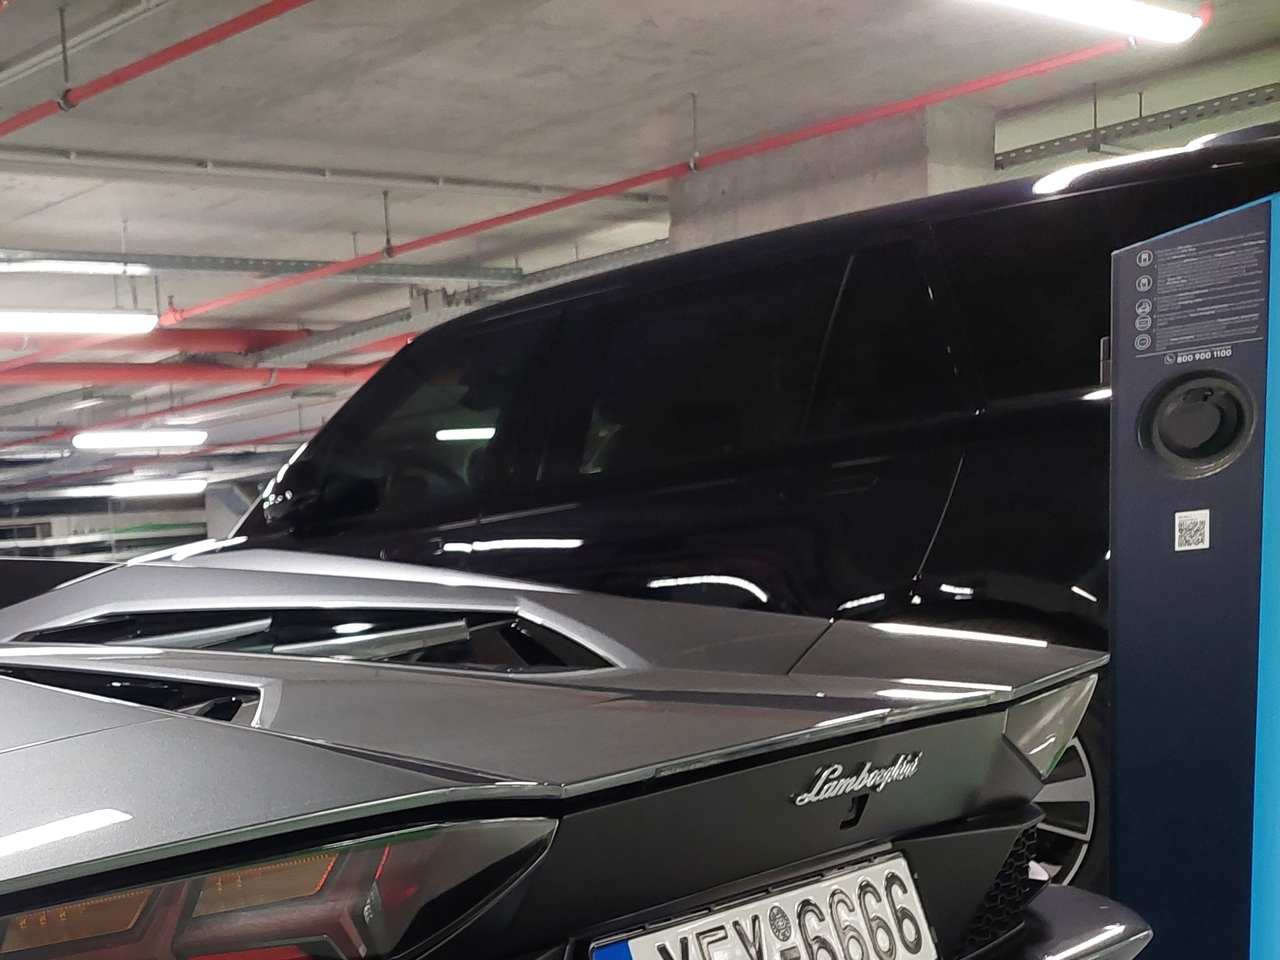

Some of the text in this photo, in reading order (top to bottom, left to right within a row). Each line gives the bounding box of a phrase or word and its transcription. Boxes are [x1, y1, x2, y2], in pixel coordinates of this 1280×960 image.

[1177, 354, 1194, 364] 800
[1195, 351, 1212, 361] 900
[1213, 349, 1232, 358] 1100
[794, 751, 923, 806] Lamborghini
